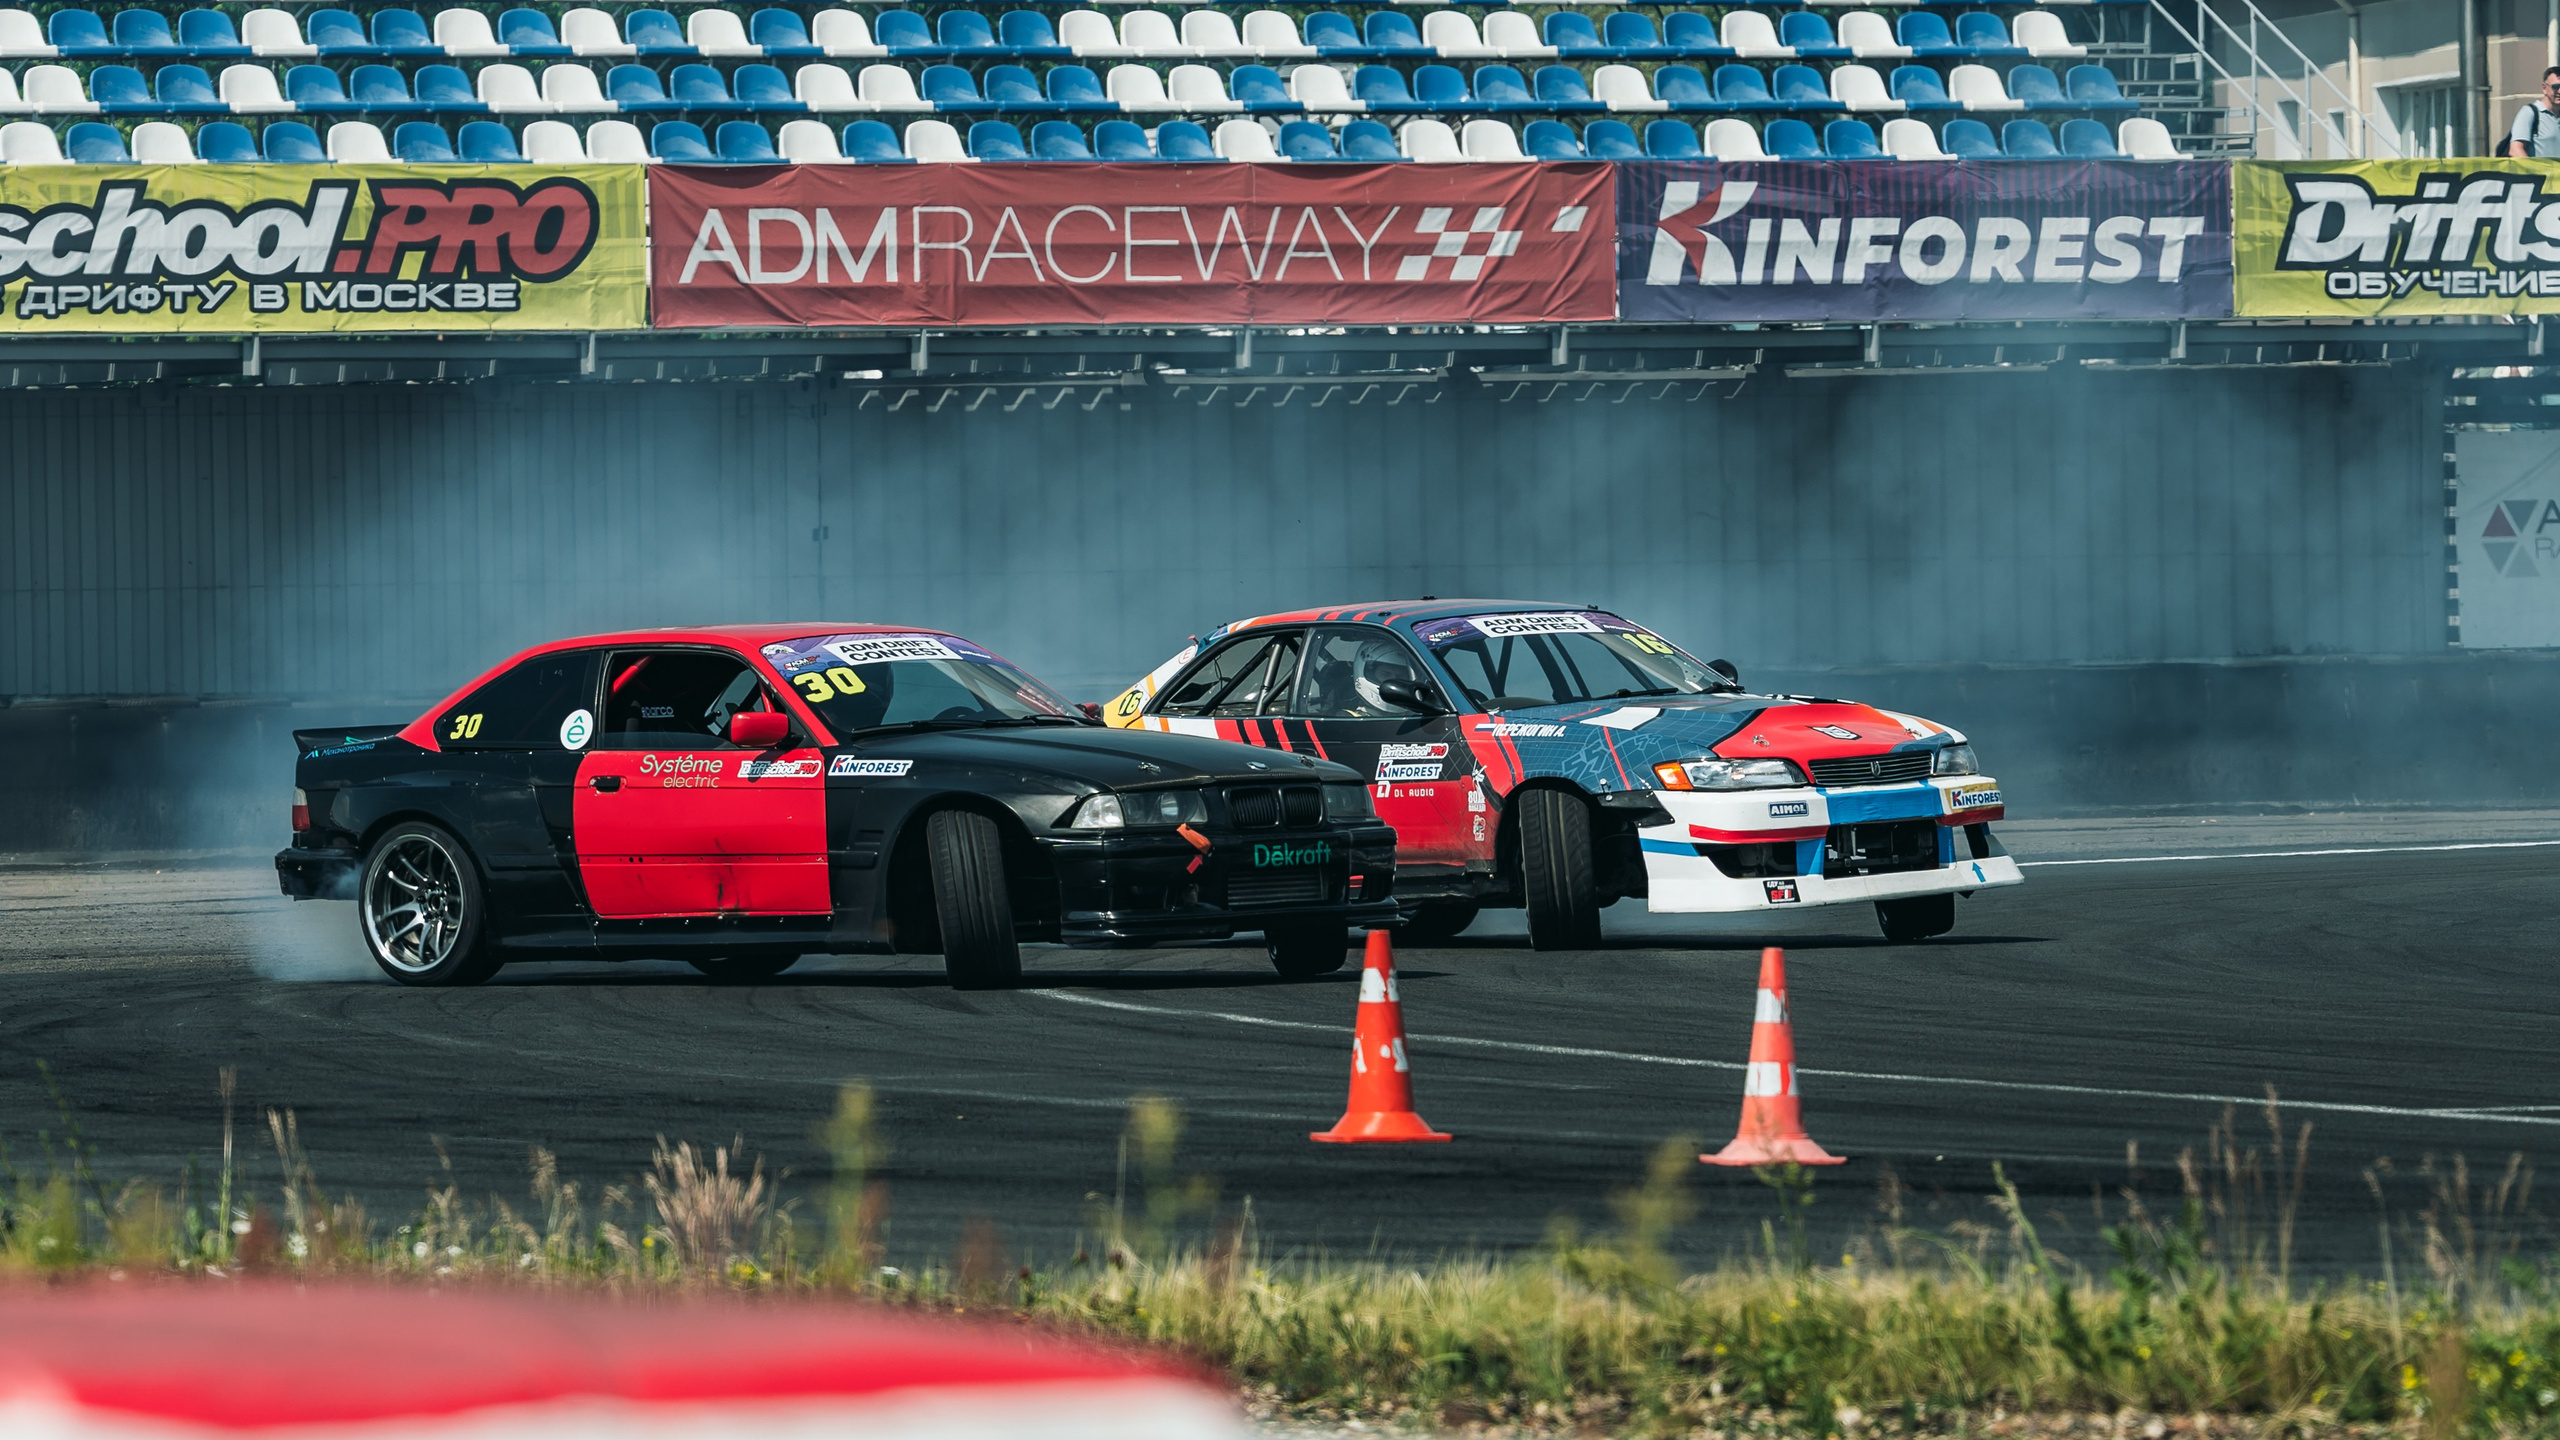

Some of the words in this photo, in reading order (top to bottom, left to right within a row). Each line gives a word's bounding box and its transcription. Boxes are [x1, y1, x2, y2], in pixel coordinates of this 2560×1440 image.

[1646, 181, 2204, 286] KINFOREST
[20, 284, 233, 315] ДРИФТУ
[253, 284, 284, 309] В
[305, 281, 517, 309] МОСКВЕ
[1484, 617, 1525, 627] ADM
[1527, 616, 1579, 624] DRIFT
[1491, 623, 1590, 634] CONTEST
[839, 641, 882, 654] ADM
[882, 640, 935, 650] DRIFT
[1621, 633, 1675, 655] 16
[849, 648, 947, 661] CONTEST
[793, 667, 866, 703] 30
[1118, 691, 1143, 716] 16
[450, 713, 483, 739] 30
[640, 754, 723, 776] Systême
[831, 757, 910, 773] KINFOREST
[1377, 762, 1440, 778] KINFOREST
[663, 773, 720, 788] electric
[1394, 788, 1404, 798] DL
[1408, 788, 1434, 797] AUDIO
[1771, 804, 1807, 815] AIMOL
[1254, 840, 1331, 867] Dēkraft
